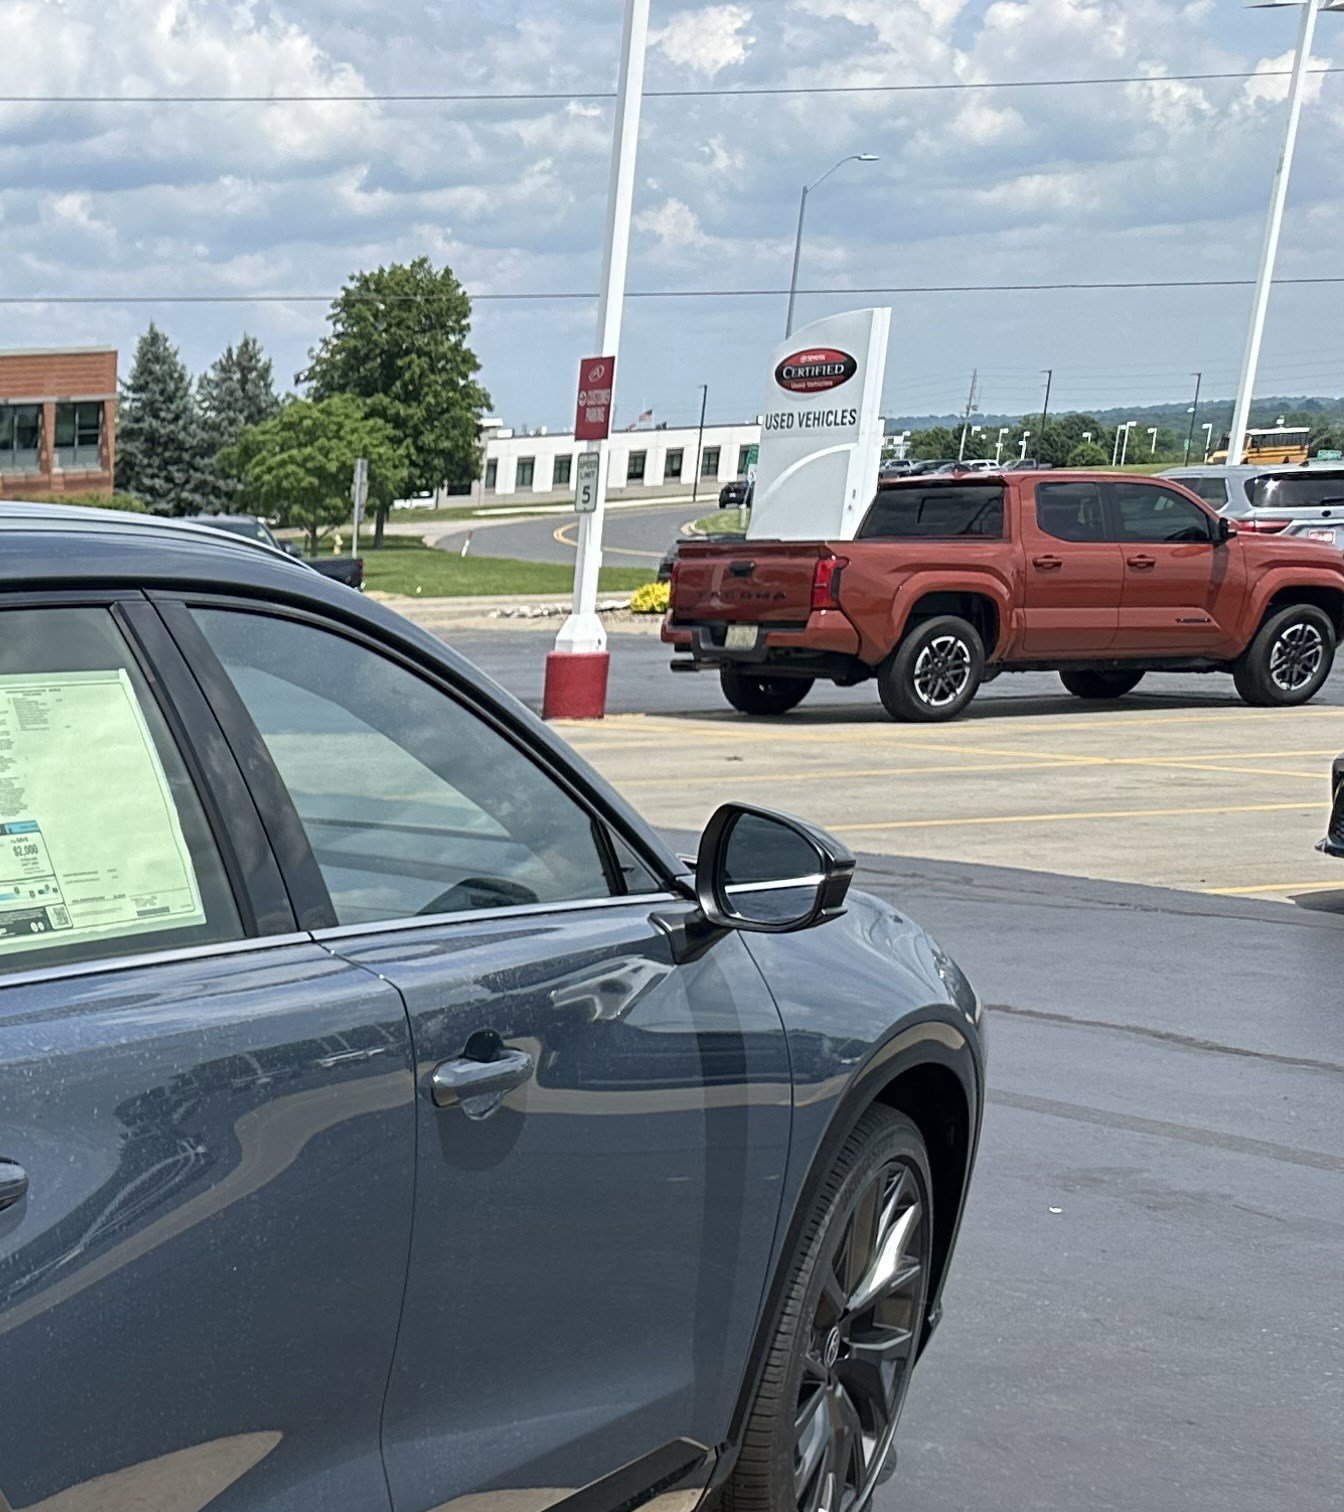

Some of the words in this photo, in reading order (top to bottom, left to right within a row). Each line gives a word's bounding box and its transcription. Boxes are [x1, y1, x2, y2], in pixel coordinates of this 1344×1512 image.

[782, 363, 845, 379] CERTIFIED
[765, 412, 794, 430] USED
[798, 408, 857, 428] VEHICLES
[581, 485, 591, 504] 5
